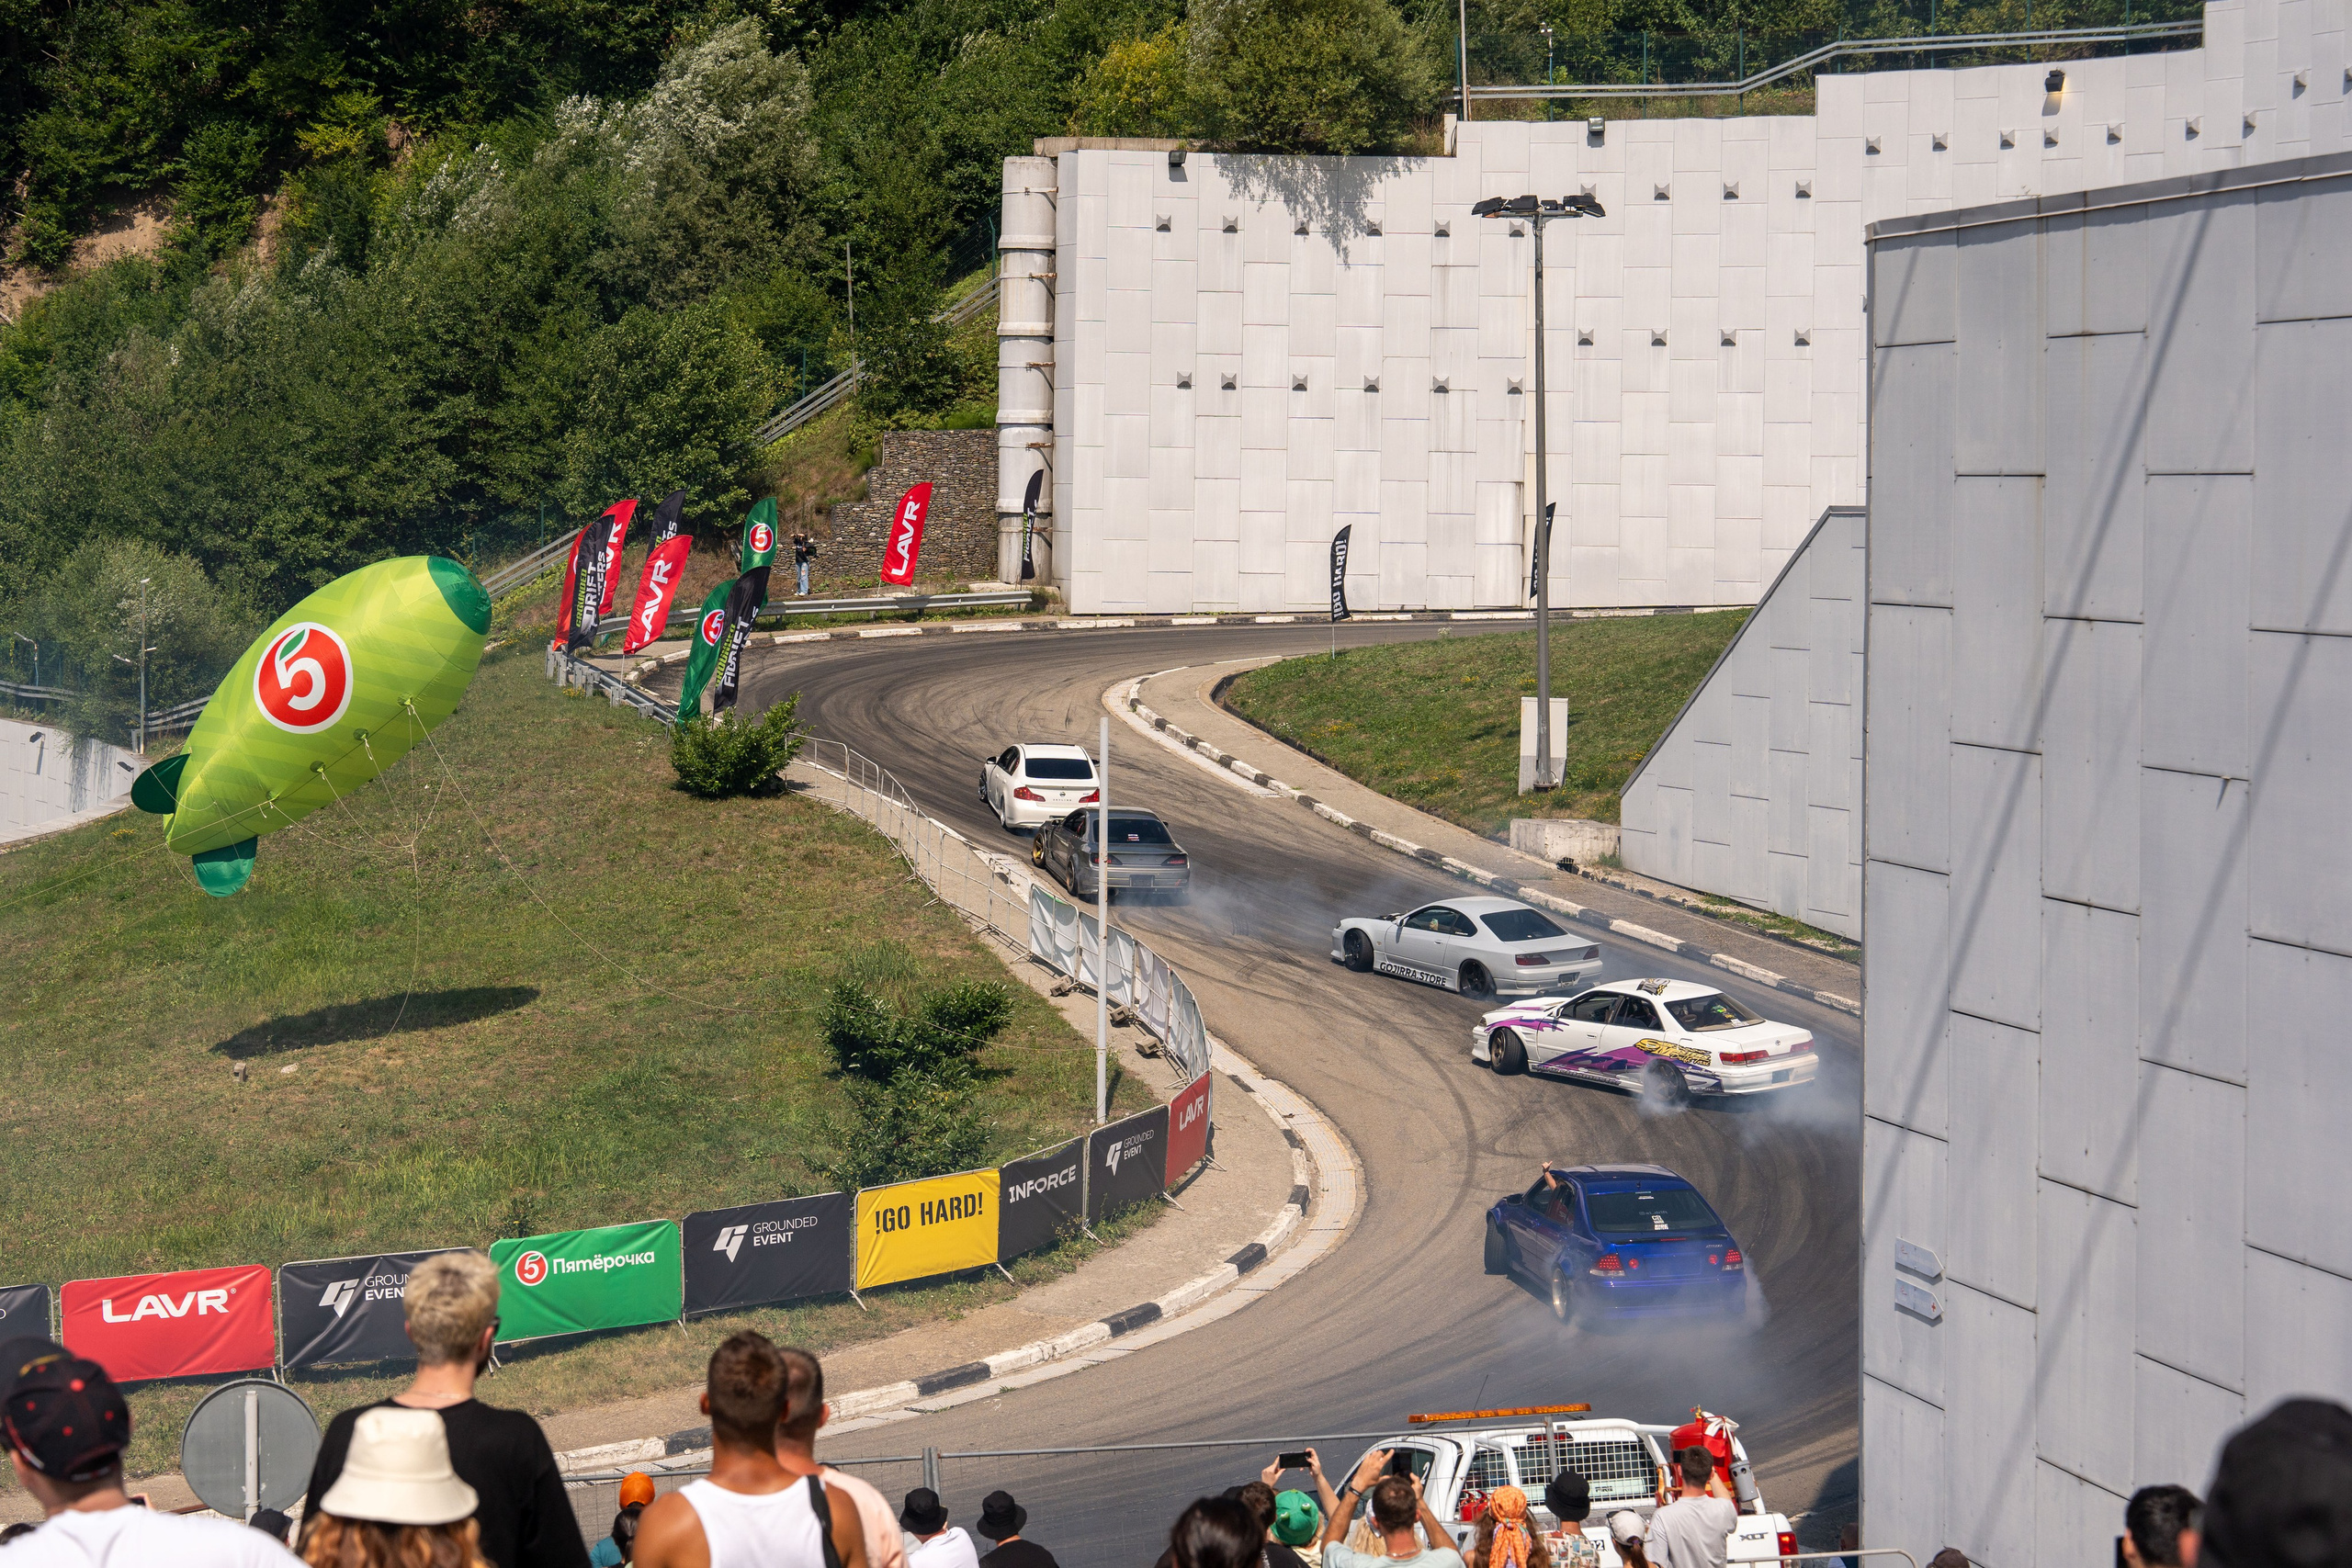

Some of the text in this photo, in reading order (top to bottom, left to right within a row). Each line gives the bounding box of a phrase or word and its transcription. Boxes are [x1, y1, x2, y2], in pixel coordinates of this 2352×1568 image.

[891, 501, 921, 576] LAVR
[275, 627, 326, 711] 5
[1380, 962, 1447, 987] GOJIRRA.STORE
[1179, 1095, 1204, 1132] LAVR
[1124, 1129, 1155, 1148] GROUNDED
[1124, 1145, 1142, 1160] EVENT
[1009, 1164, 1076, 1203] INFORCE
[752, 1215, 818, 1234] GROUNDED
[876, 1192, 983, 1235] !GO HARD!
[753, 1232, 794, 1247] EVENT
[553, 1251, 655, 1275] Пятёрочка
[365, 1287, 406, 1301] EVEN
